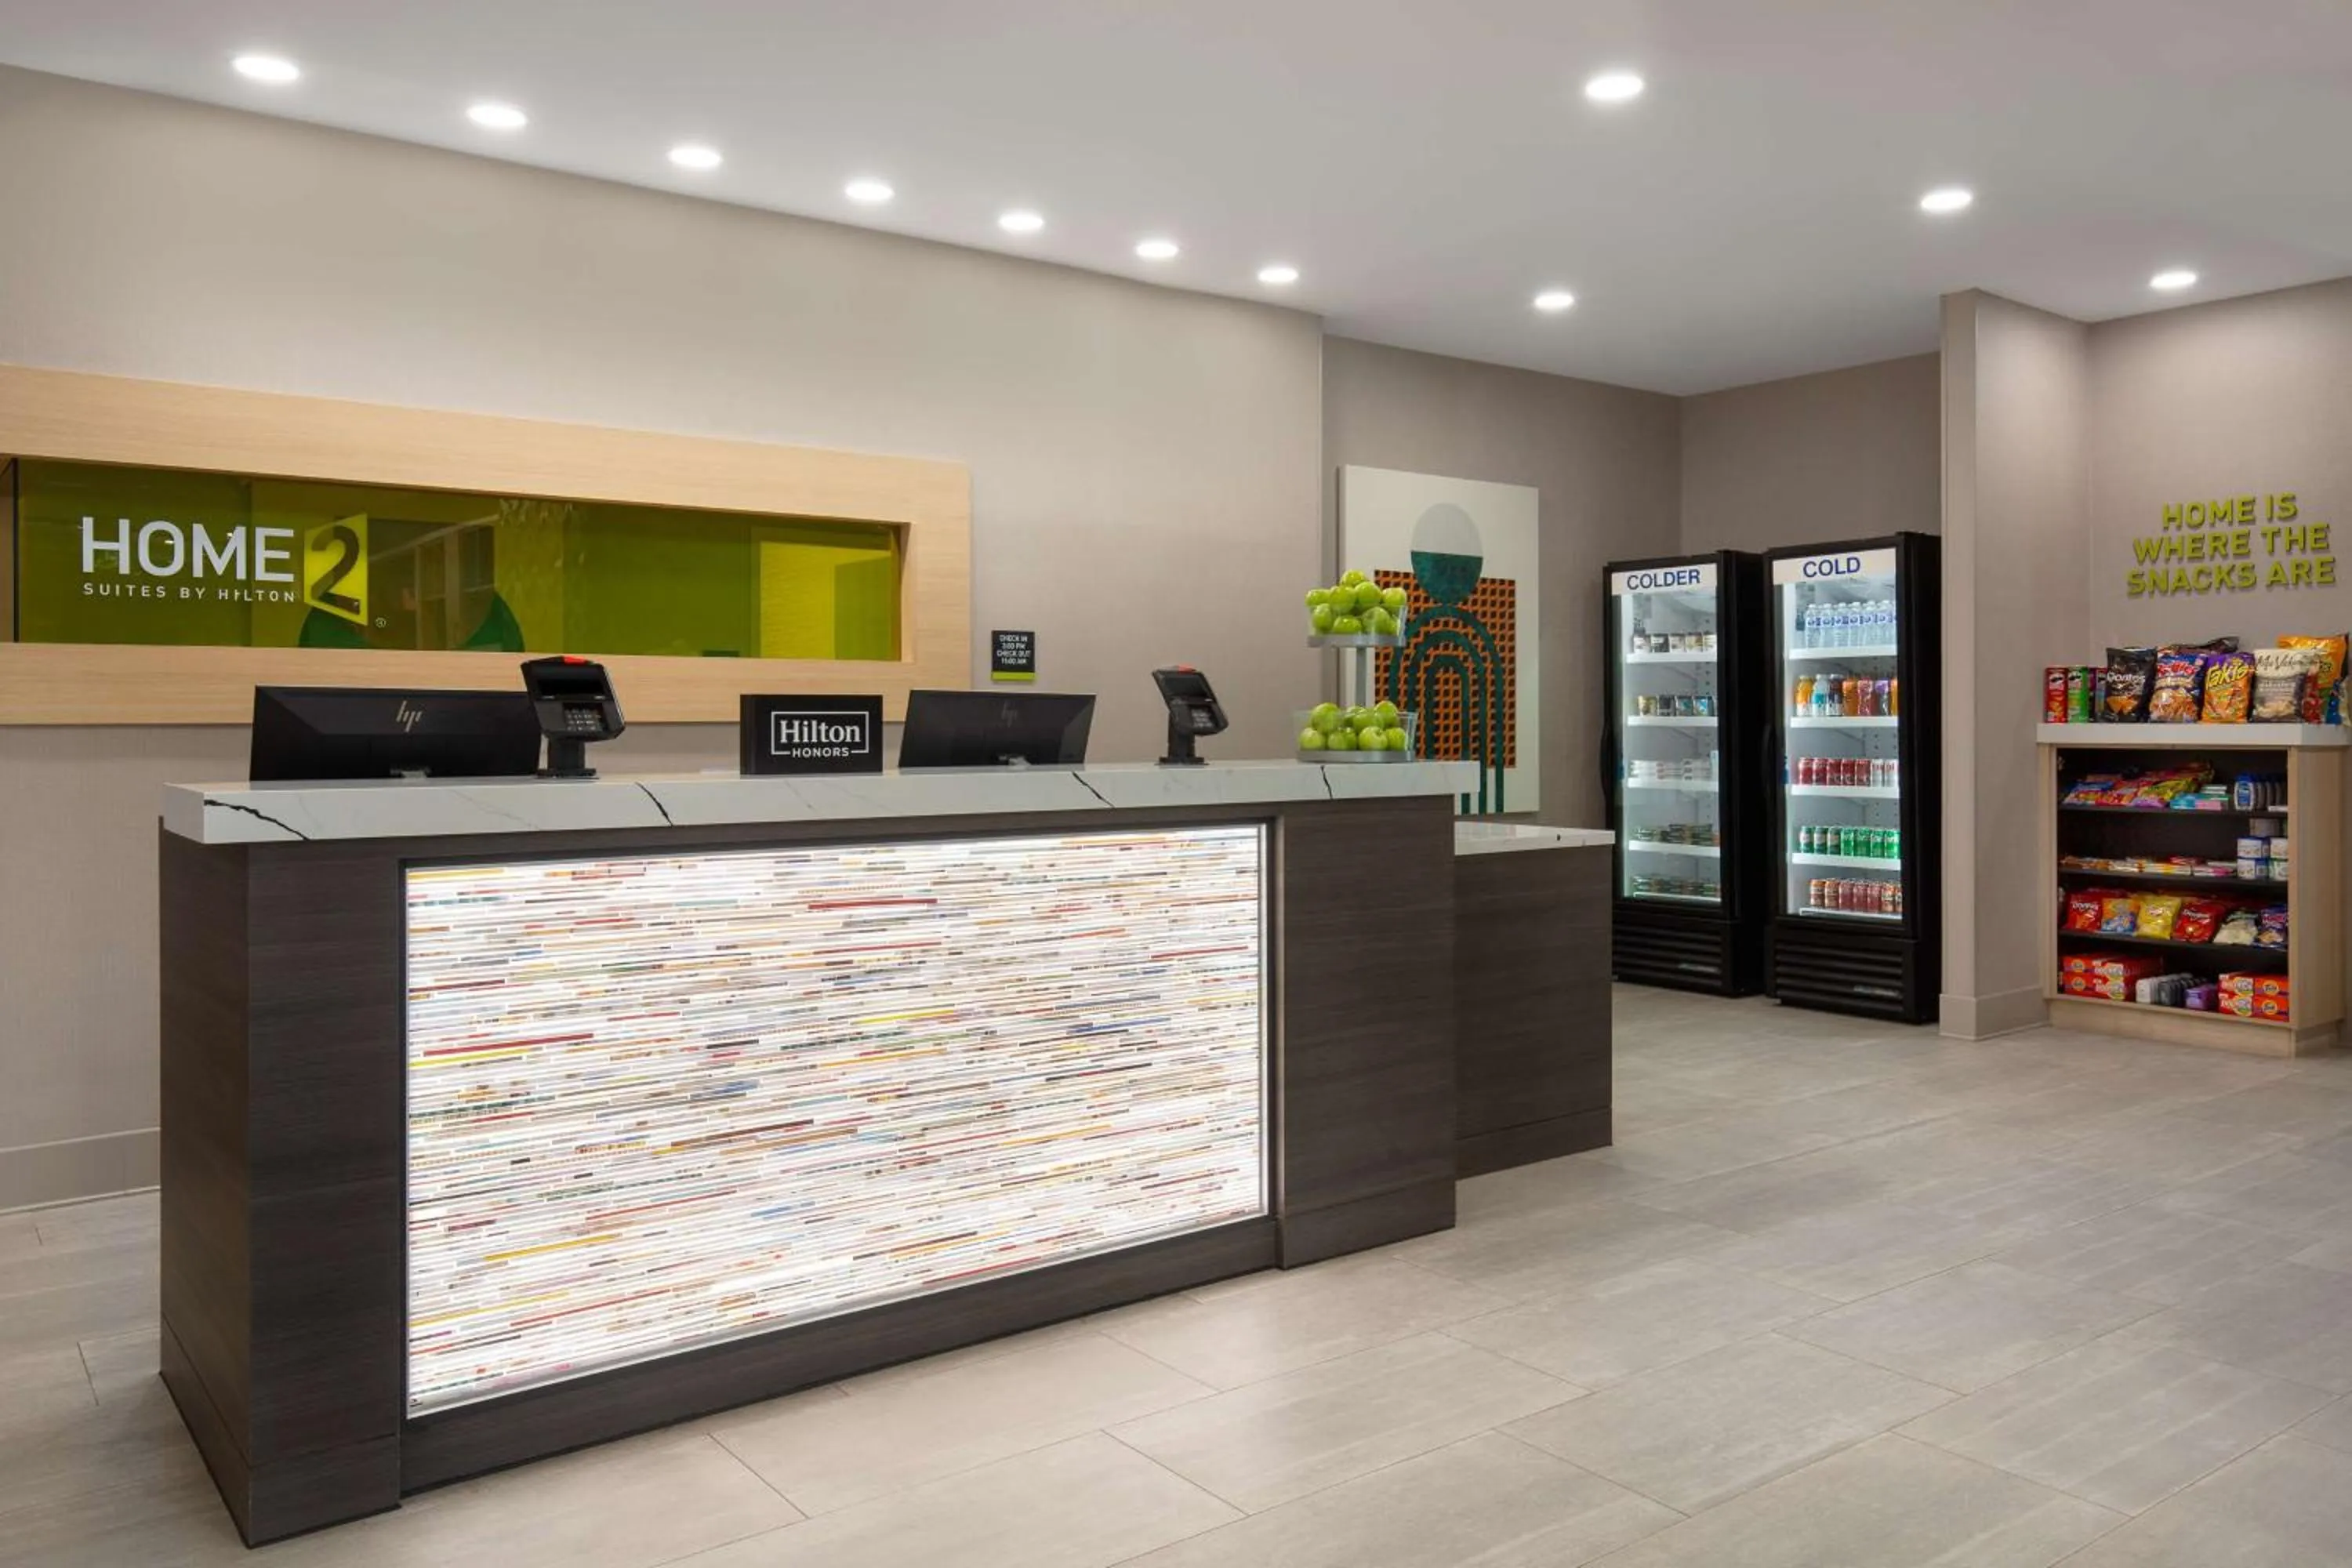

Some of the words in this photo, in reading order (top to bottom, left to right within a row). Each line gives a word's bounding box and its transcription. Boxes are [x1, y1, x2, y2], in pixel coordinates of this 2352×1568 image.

[2162, 497, 2256, 532] HOME
[2266, 492, 2298, 521] IS
[82, 517, 295, 582] HOME
[2132, 528, 2251, 564] WHERE
[2261, 522, 2329, 554] THE
[1627, 568, 1700, 590] COLDER
[1803, 557, 1860, 578] COLD
[2127, 561, 2256, 597] SNACKS
[2266, 557, 2336, 588] ARE
[83, 583, 166, 598] SUITES
[180, 587, 205, 599] BY
[218, 589, 296, 602] HILTON
[780, 720, 861, 743] Hilton
[792, 747, 849, 758] HONORS
